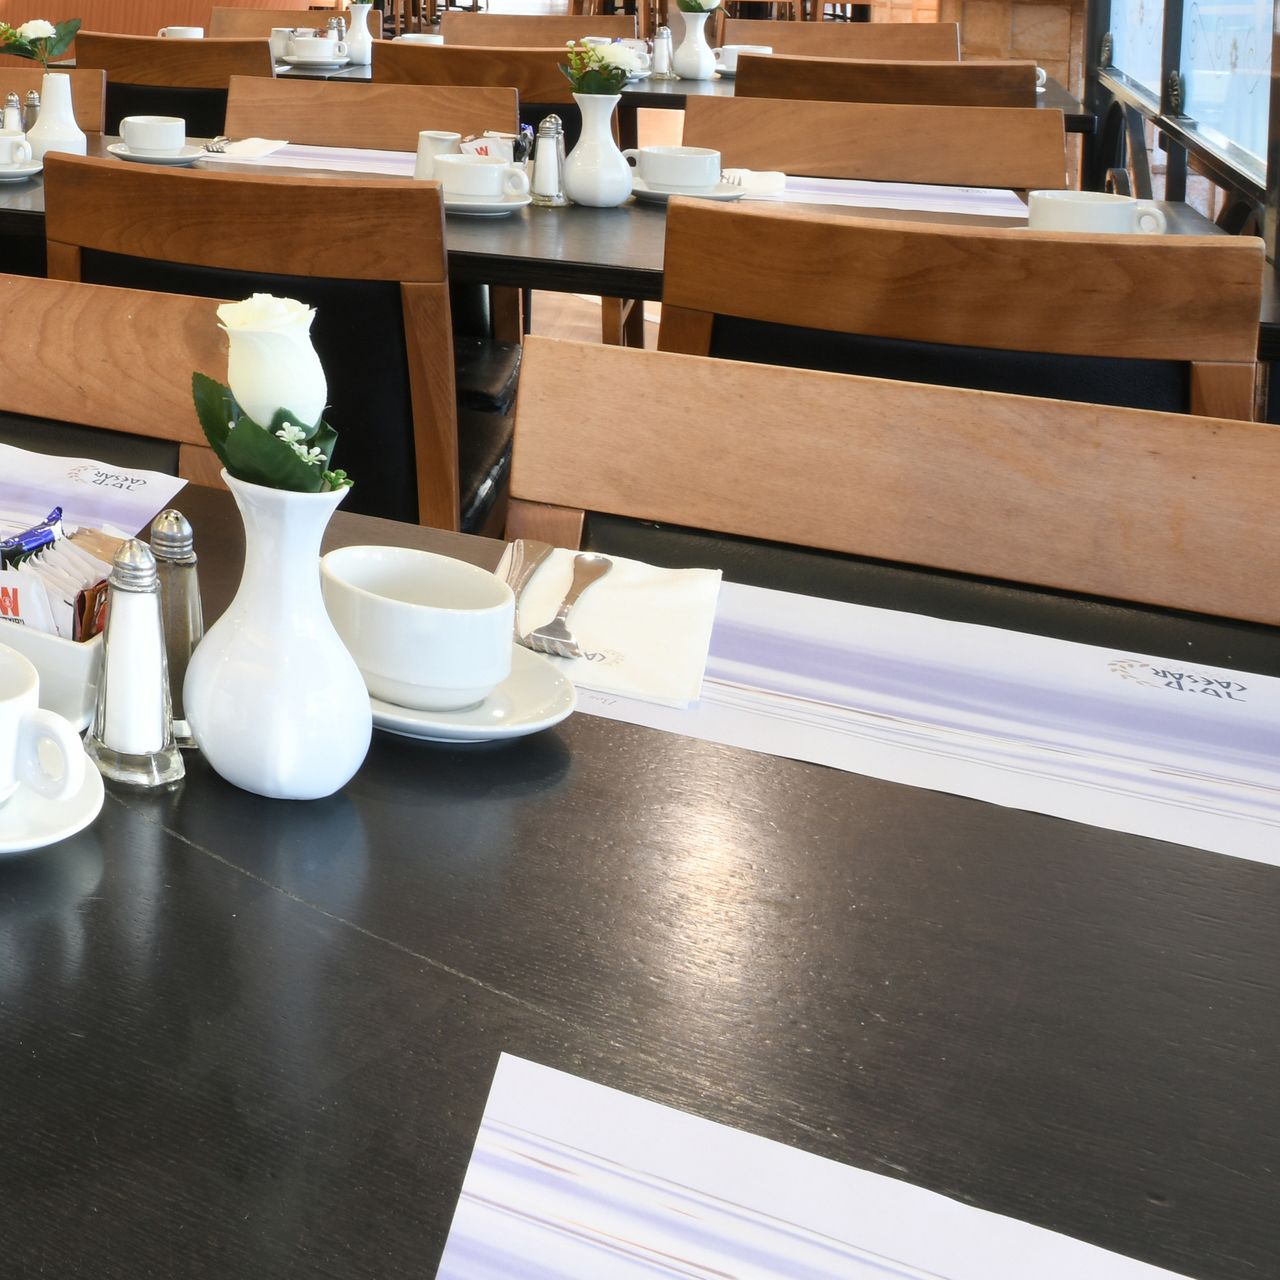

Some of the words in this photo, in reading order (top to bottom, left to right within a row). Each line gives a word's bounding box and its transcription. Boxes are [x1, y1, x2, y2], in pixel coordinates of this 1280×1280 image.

[92, 478, 139, 492] קיסר
[94, 470, 148, 487] CAESAR
[1151, 667, 1248, 692] CAESAR
[1165, 680, 1248, 703] קיסר
